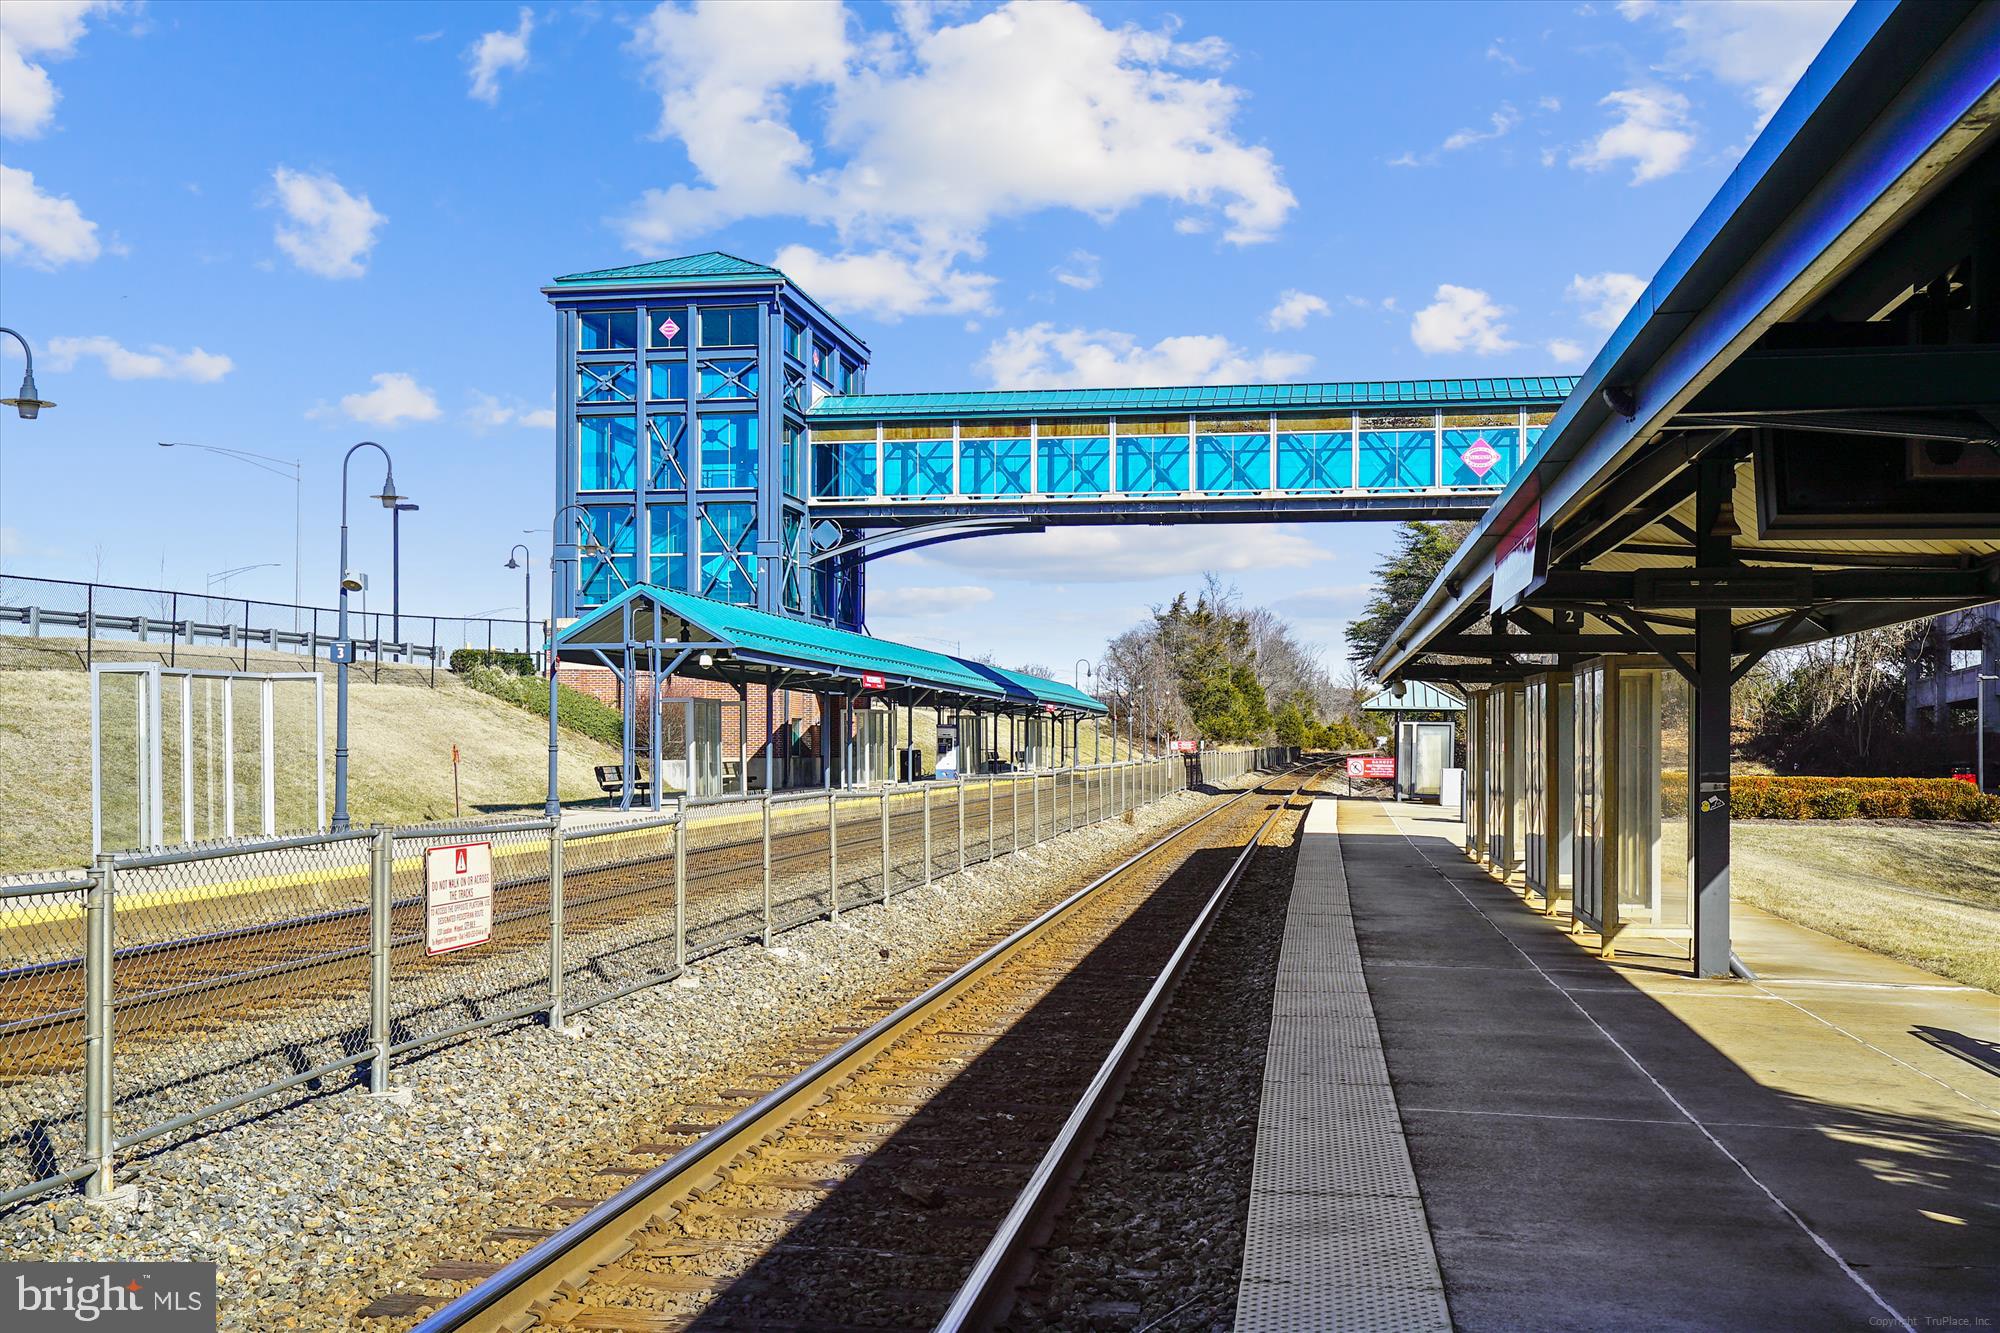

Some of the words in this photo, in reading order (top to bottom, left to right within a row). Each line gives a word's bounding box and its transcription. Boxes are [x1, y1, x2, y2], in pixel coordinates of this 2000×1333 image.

[1565, 611, 1575, 623] 2
[337, 647, 345, 659] 3
[439, 879, 448, 890] NOT
[474, 873, 489, 884] ACROSS
[449, 890, 458, 901] THE
[458, 888, 474, 899] TRACKS
